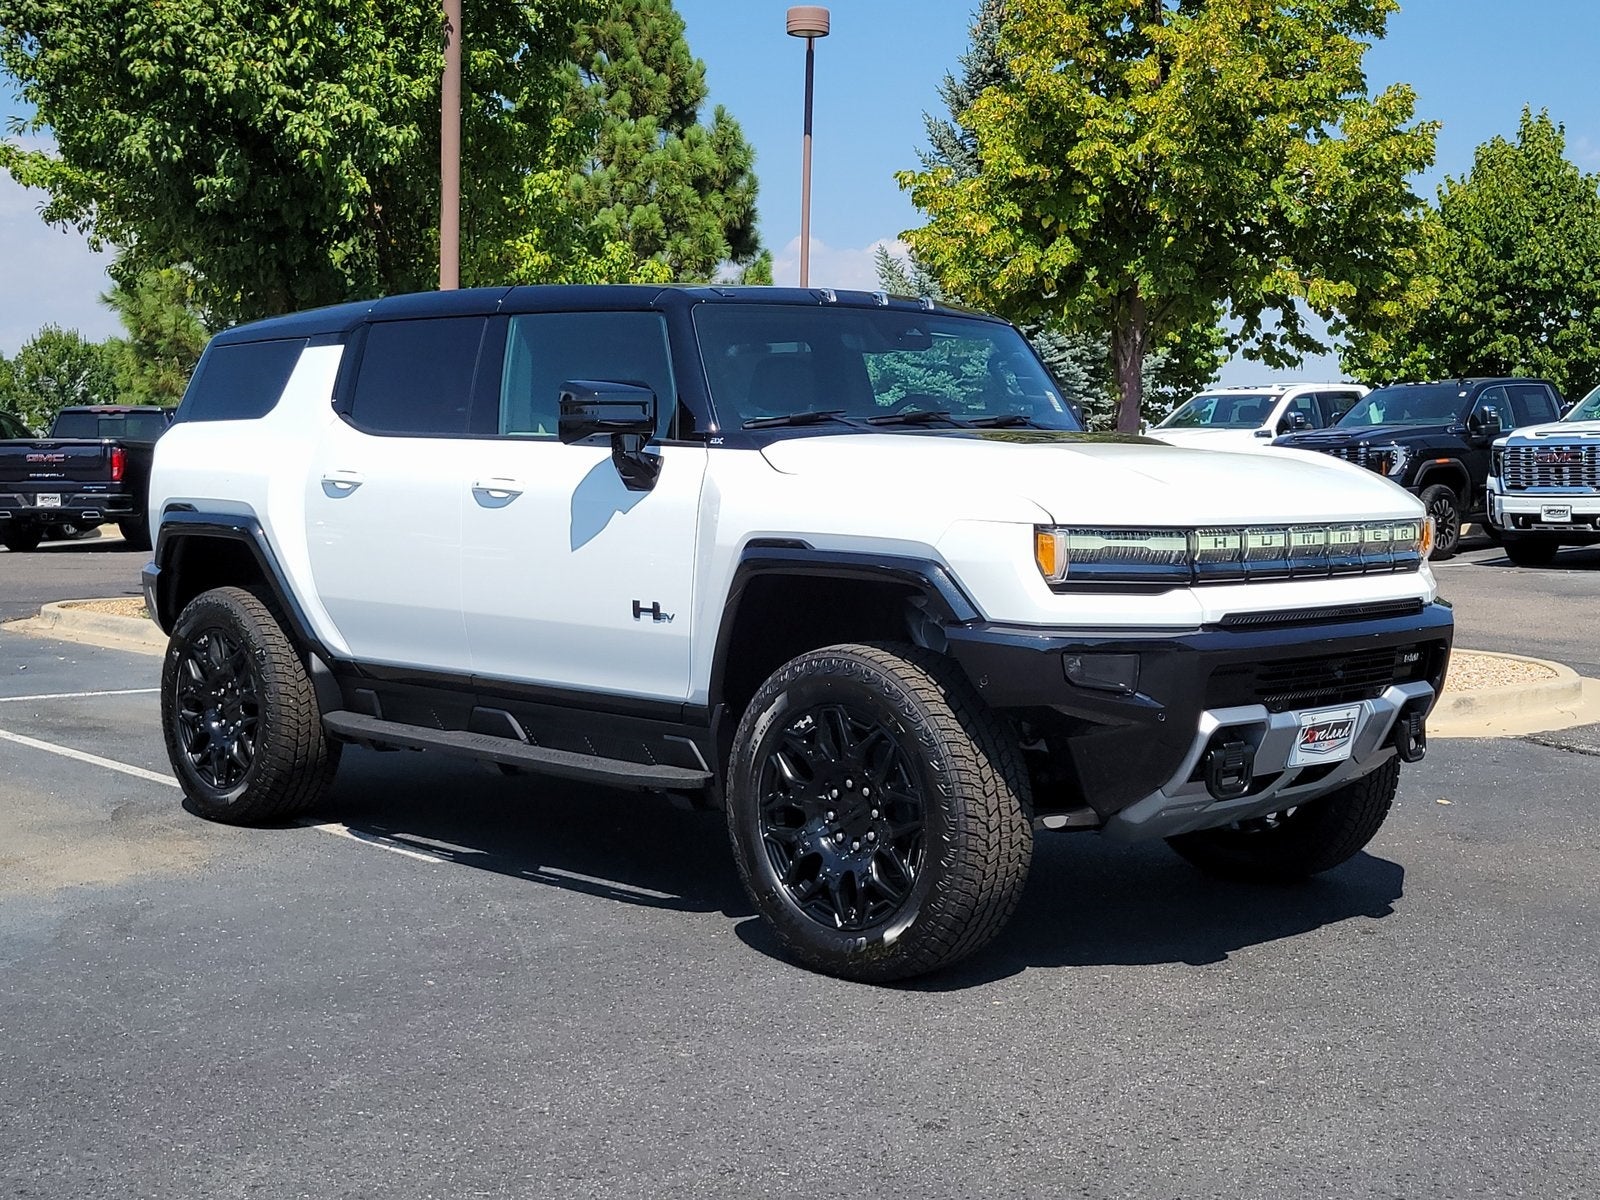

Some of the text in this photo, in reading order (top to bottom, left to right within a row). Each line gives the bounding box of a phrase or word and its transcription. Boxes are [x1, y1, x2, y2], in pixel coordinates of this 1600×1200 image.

[26, 454, 65, 462] GMC
[1534, 452, 1582, 463] GMC
[1213, 529, 1409, 549] HUMMER
